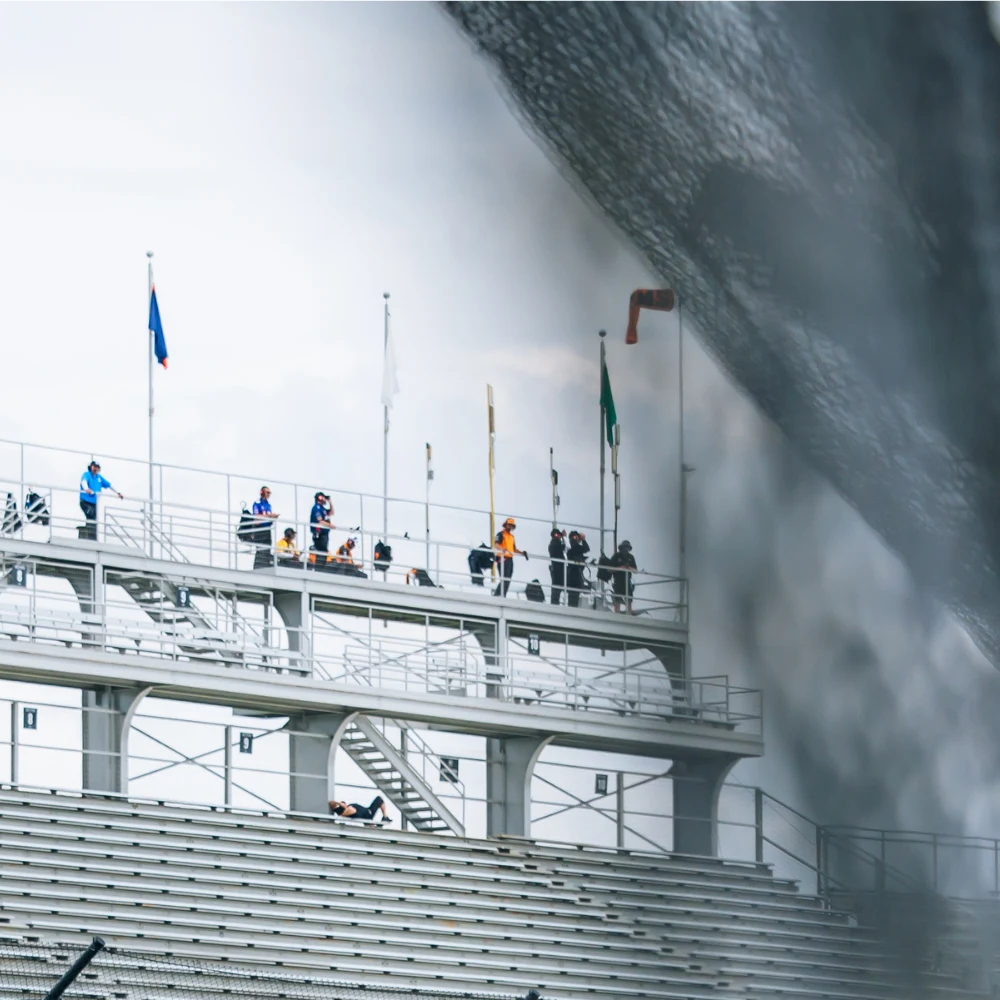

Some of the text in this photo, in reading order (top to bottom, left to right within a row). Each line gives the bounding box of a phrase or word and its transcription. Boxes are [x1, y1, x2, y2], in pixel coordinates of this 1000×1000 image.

[16, 569, 23, 583] 8
[180, 591, 187, 604] 9
[530, 638, 539, 651] 10
[243, 737, 250, 750] 9
